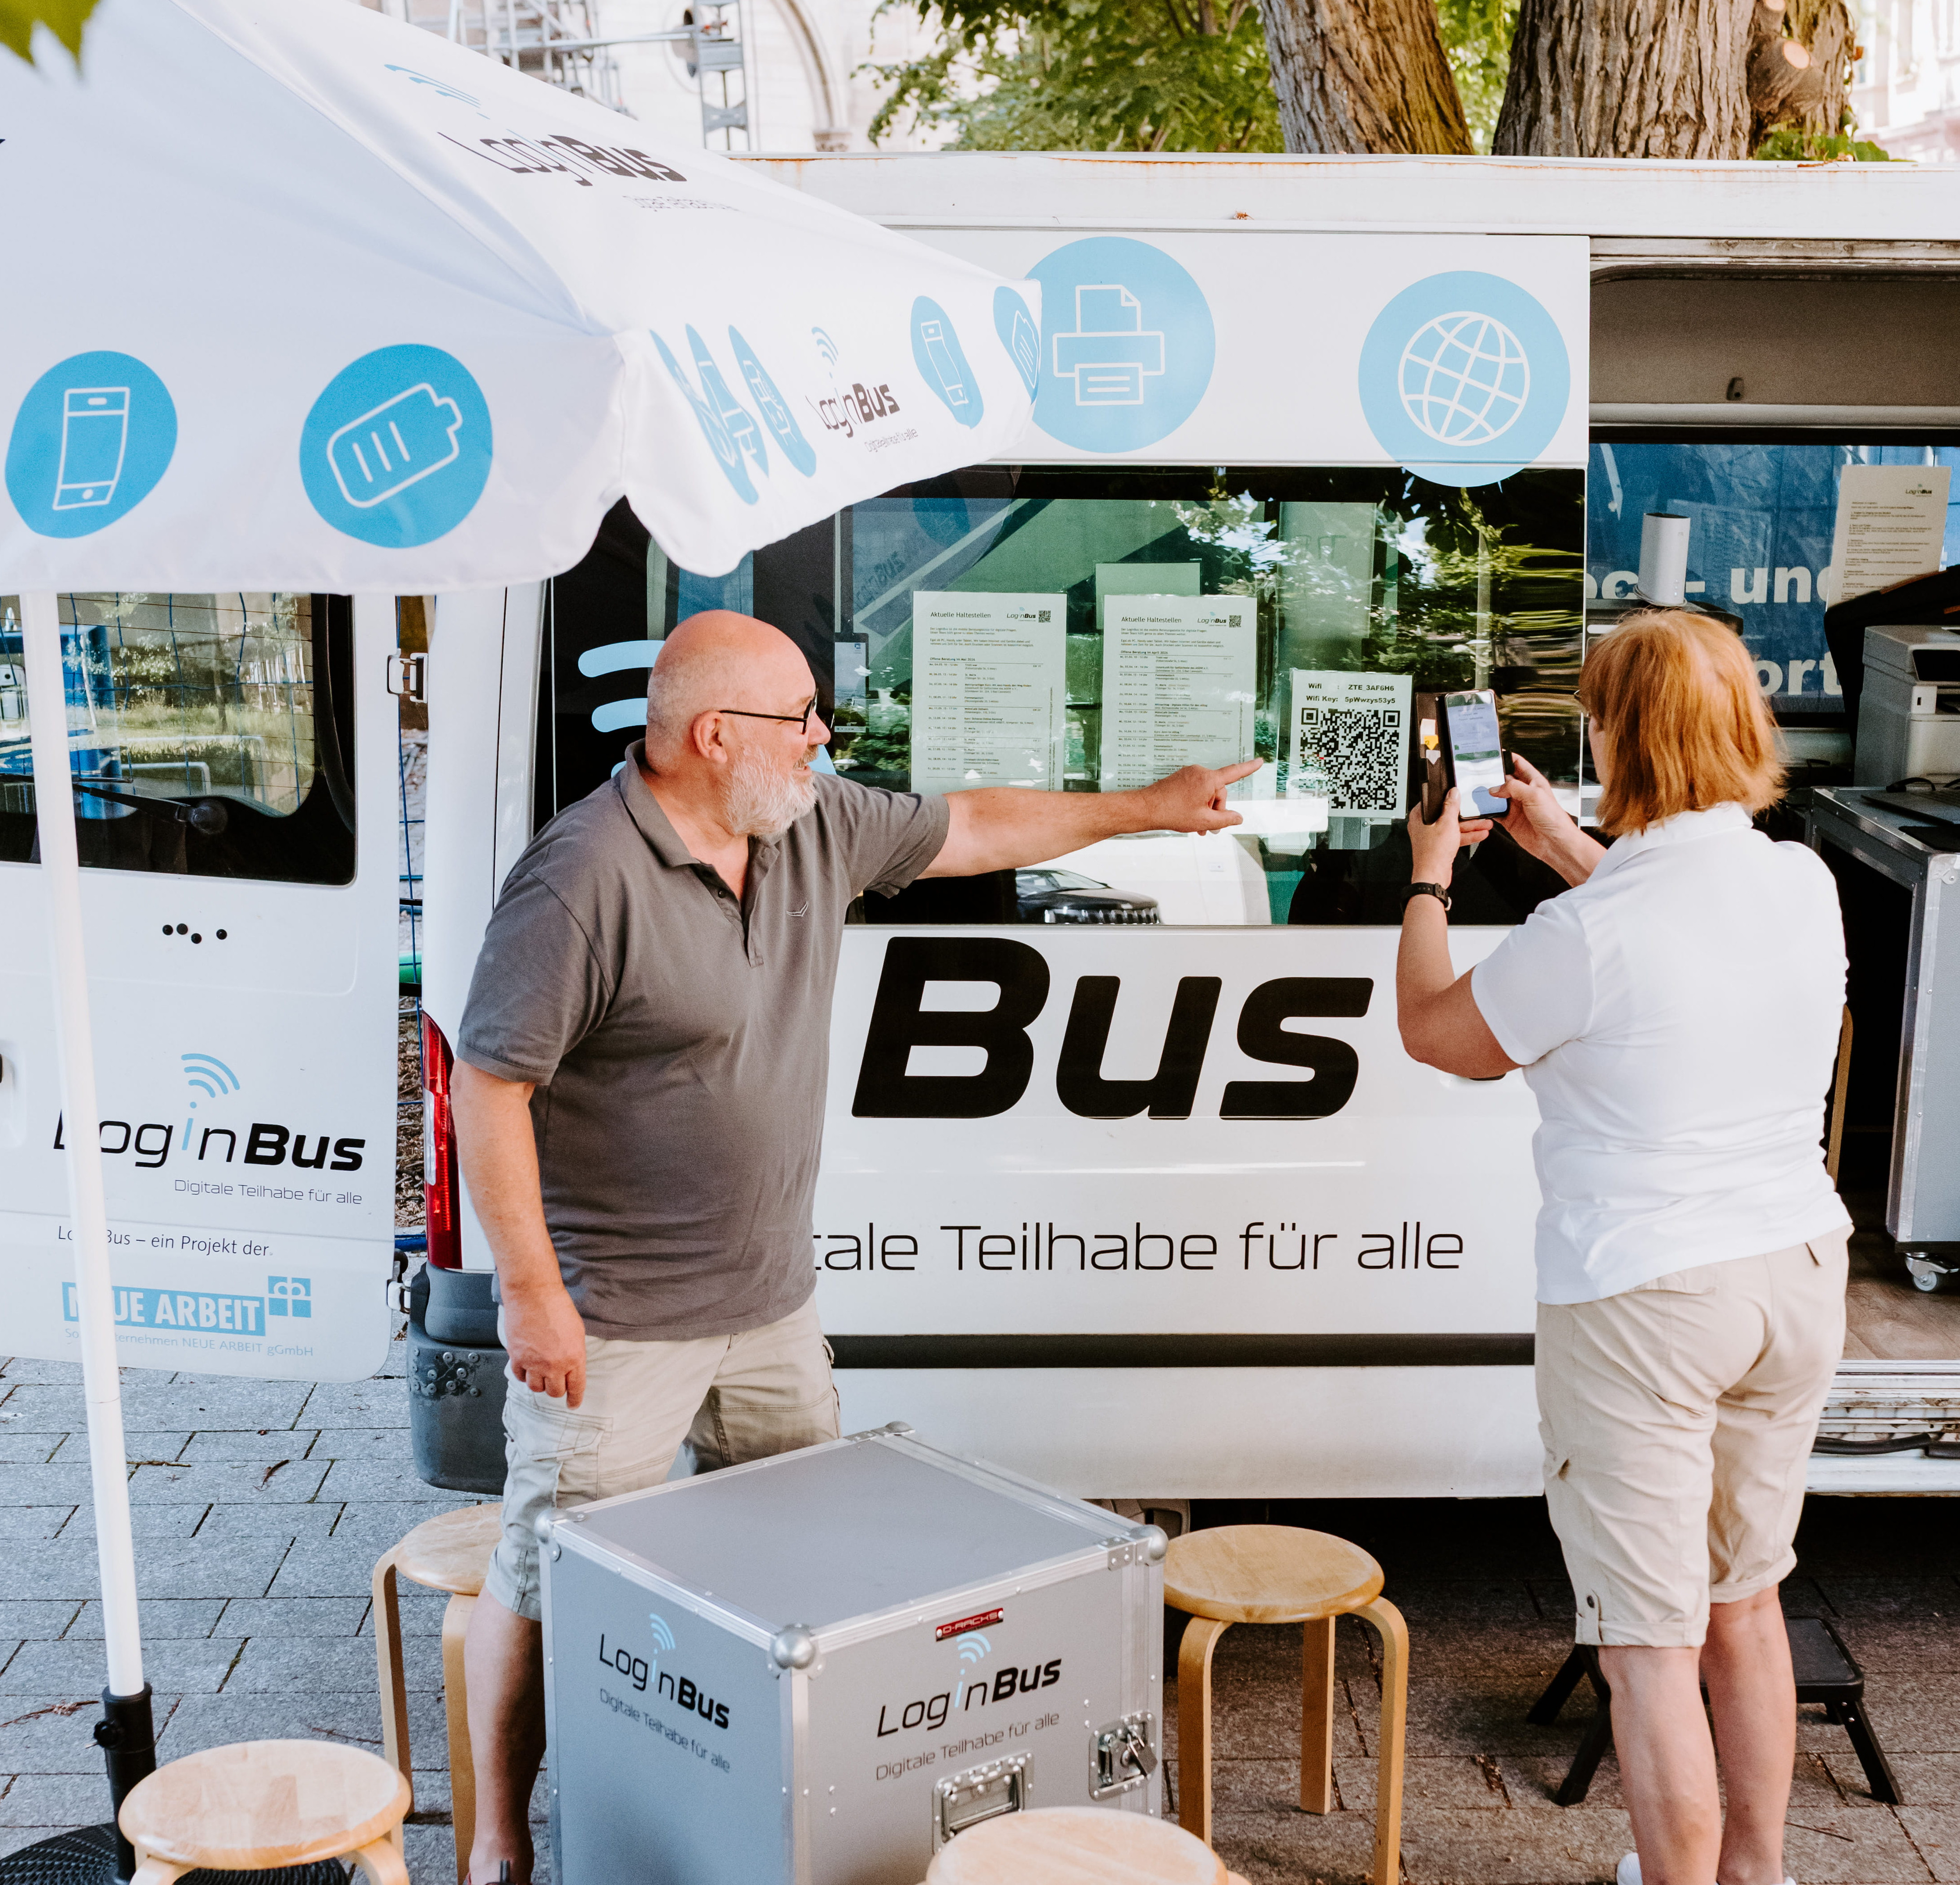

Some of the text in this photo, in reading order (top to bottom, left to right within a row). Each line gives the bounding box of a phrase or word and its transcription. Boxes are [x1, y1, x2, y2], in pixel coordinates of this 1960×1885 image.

[805, 383, 900, 438] LoginBus
[175, 1179, 362, 1205] Digitale Teilhabe für alle
[151, 1234, 174, 1249] ein
[181, 1235, 237, 1256] Projekt
[243, 1240, 269, 1256] der
[941, 1222, 1217, 1271] Teilhabe
[1239, 1222, 1337, 1271] für
[1358, 1221, 1464, 1270] alle
[155, 1294, 260, 1331] ARBEIT
[183, 1337, 215, 1349] NEUE
[220, 1340, 263, 1353] ARBEIT
[267, 1345, 313, 1356] gGmbH
[599, 1633, 730, 1730] LoginBus
[877, 1658, 1062, 1738] LoginBus
[600, 1688, 730, 1773] Digitale Teilhabe für alle
[876, 1712, 1060, 1781] Digitale Teilhabe für alle
